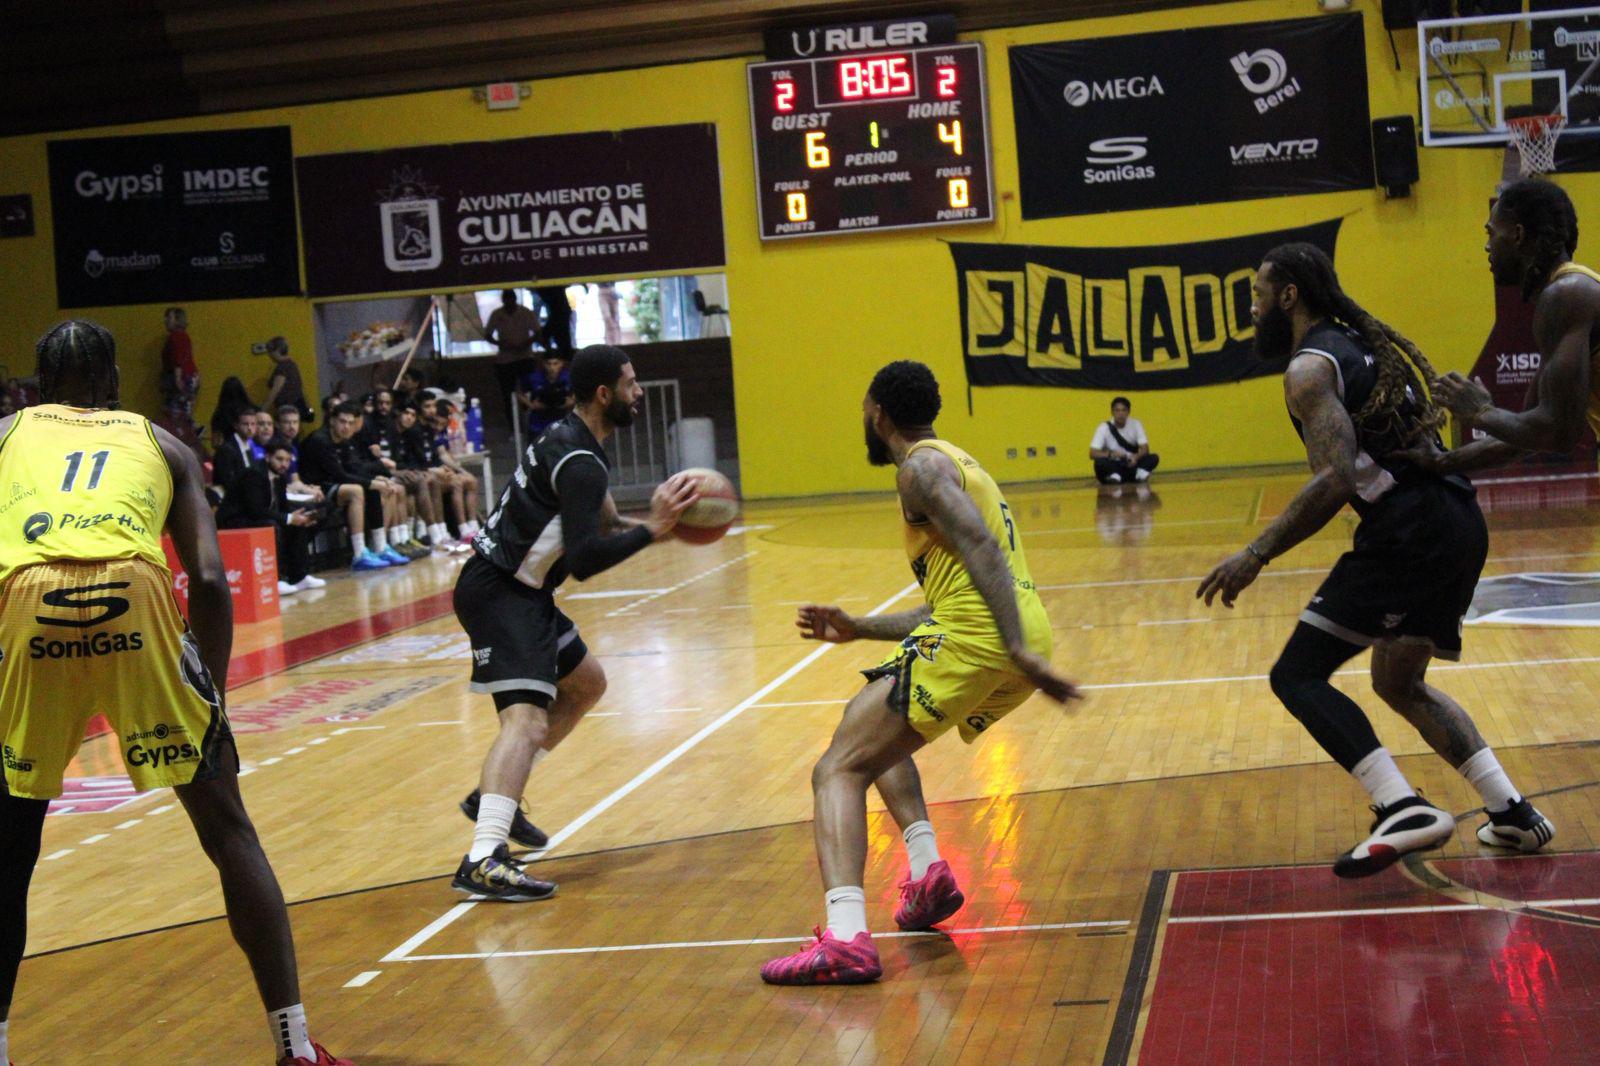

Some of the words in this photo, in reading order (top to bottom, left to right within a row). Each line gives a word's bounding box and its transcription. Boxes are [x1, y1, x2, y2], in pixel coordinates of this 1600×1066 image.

[825, 22, 927, 51] RULER
[840, 58, 911, 98] 8:05
[938, 68, 956, 96] 2
[1091, 75, 1165, 101] MEGA
[776, 82, 794, 111] 2
[1253, 77, 1301, 115] Berel
[772, 112, 831, 131] GUEST
[908, 100, 961, 119] HOME
[870, 121, 879, 149] 1
[938, 119, 963, 156] 4
[806, 131, 831, 169] 6
[845, 151, 898, 167] PERIOD
[1229, 138, 1319, 160] VENTO
[74, 164, 163, 201] Gypsi
[183, 166, 269, 190] IMDEC
[835, 171, 912, 187] PLAYER-FOUL
[936, 166, 972, 178] FOULS
[1083, 163, 1156, 184] SoniGas
[457, 185, 611, 212] AYUNTAMIENTO
[617, 183, 644, 200] DE
[774, 180, 810, 192] FOULS
[948, 178, 969, 208] 0
[787, 192, 807, 221] 0
[937, 207, 978, 220] POINTS
[458, 202, 647, 244] CULIACÁN
[776, 221, 815, 233] POINTS
[839, 216, 879, 228] MATCH
[105, 251, 161, 266] madam
[191, 256, 218, 266] CLUB
[461, 250, 525, 266] CAPITAL
[532, 248, 551, 260] DE
[558, 240, 649, 258] BIENESTAR
[61, 451, 109, 491] 11
[59, 513, 114, 530] Pizza
[29, 631, 143, 660] SoniGas
